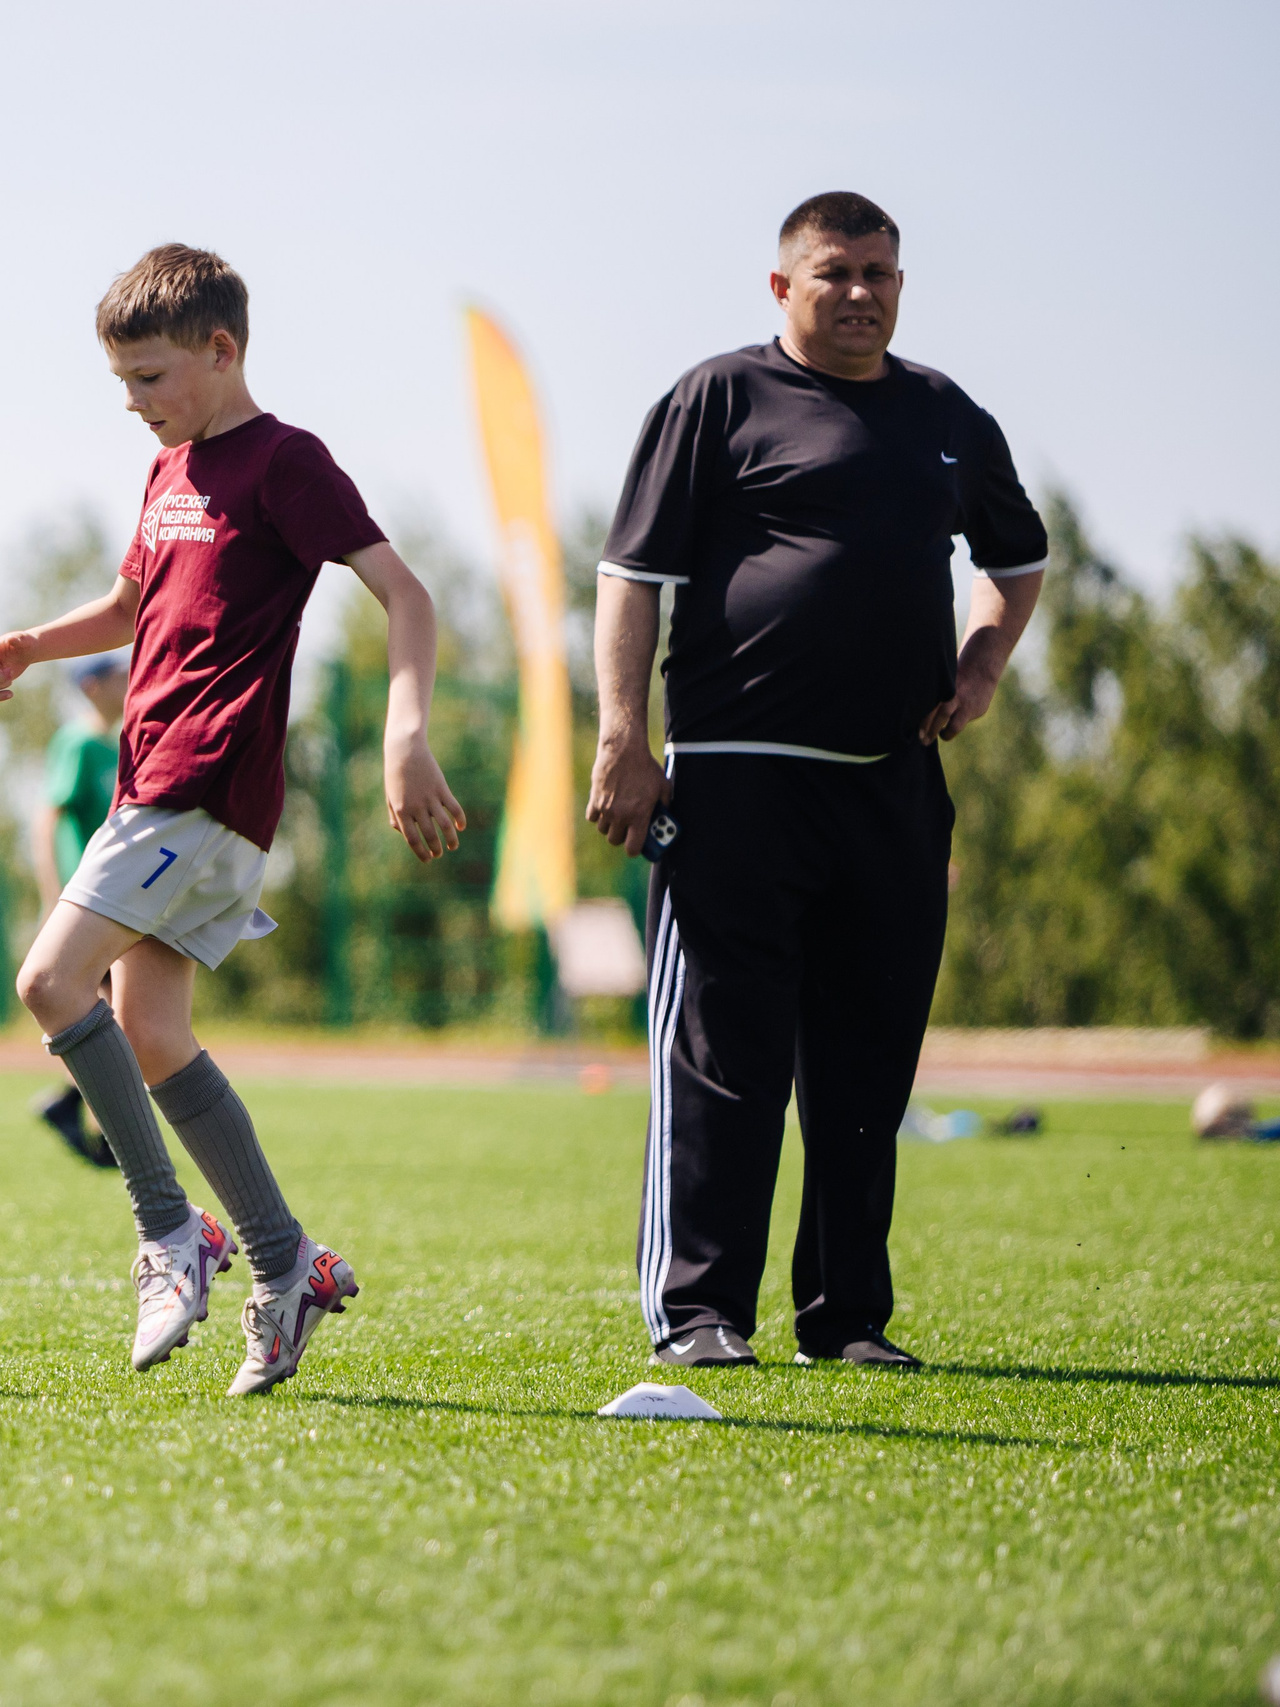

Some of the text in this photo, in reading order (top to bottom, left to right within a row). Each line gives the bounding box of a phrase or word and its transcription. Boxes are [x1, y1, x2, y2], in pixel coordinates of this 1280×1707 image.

[164, 494, 211, 509] РУССКАЯ
[161, 510, 204, 525] МЕДНАЯ
[158, 526, 215, 543] КОМПАНИЯ
[141, 847, 178, 889] 7
